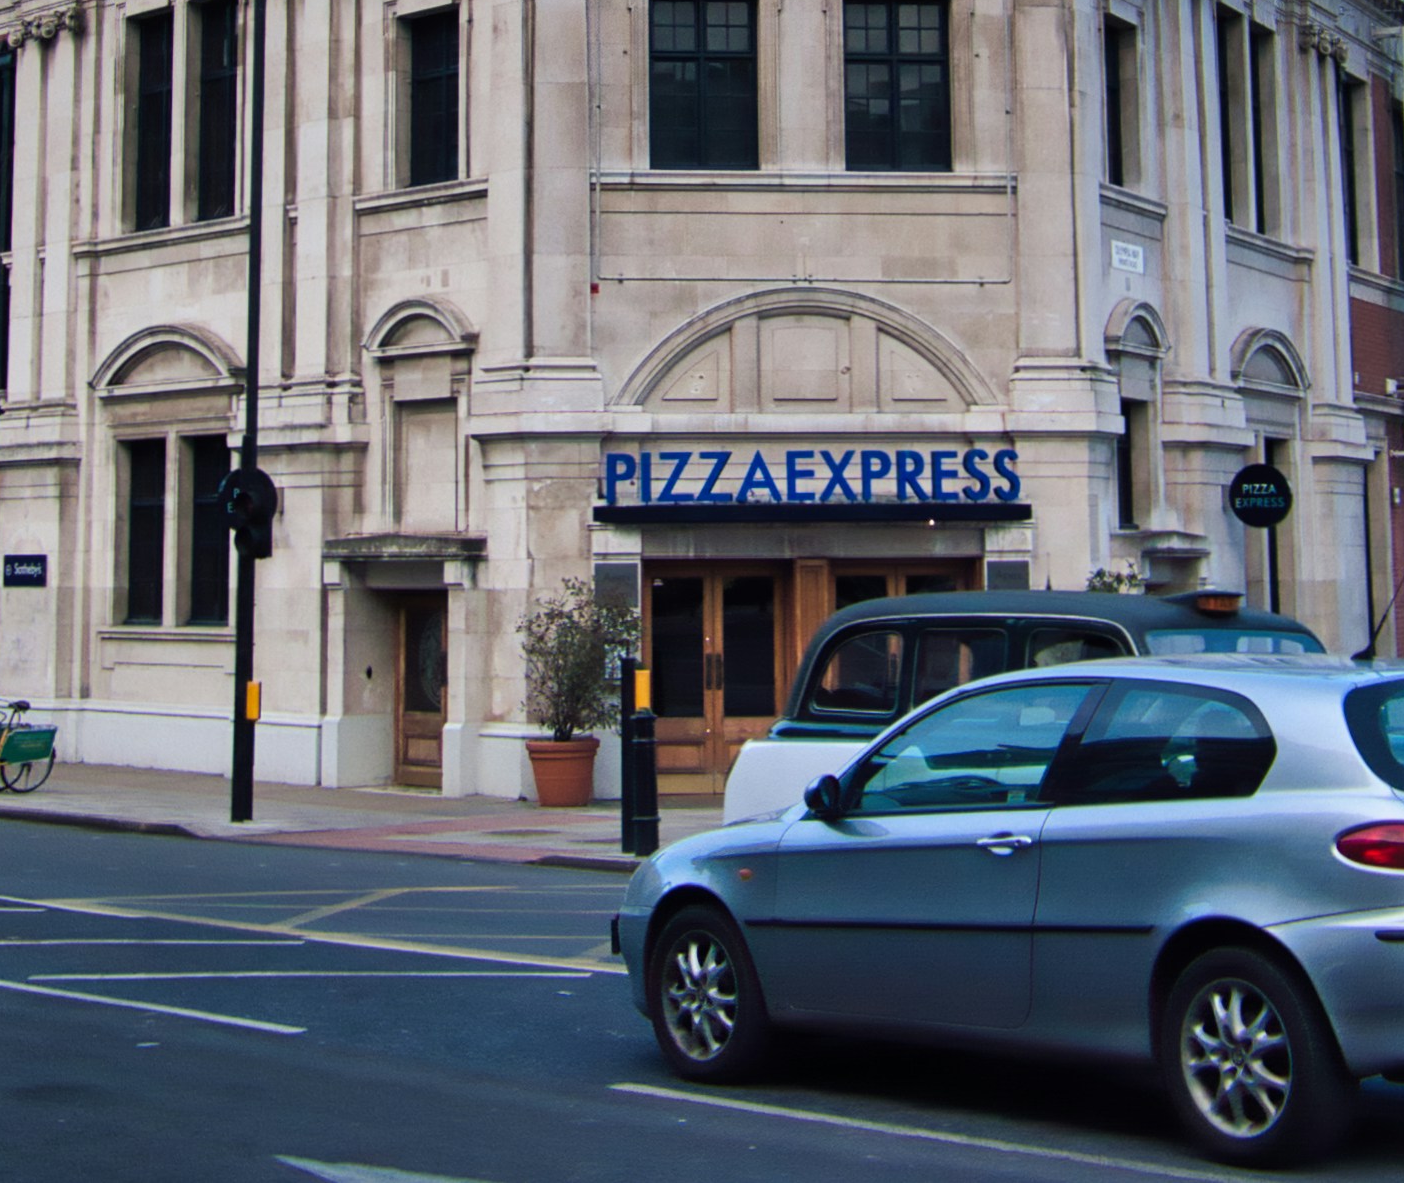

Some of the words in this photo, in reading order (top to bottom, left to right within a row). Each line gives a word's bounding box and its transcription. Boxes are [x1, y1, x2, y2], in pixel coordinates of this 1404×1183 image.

[604, 448, 1022, 505] PIZZAEXPRESS
[1241, 484, 1277, 495] PIZZA
[1235, 497, 1285, 508] EXPRESS
